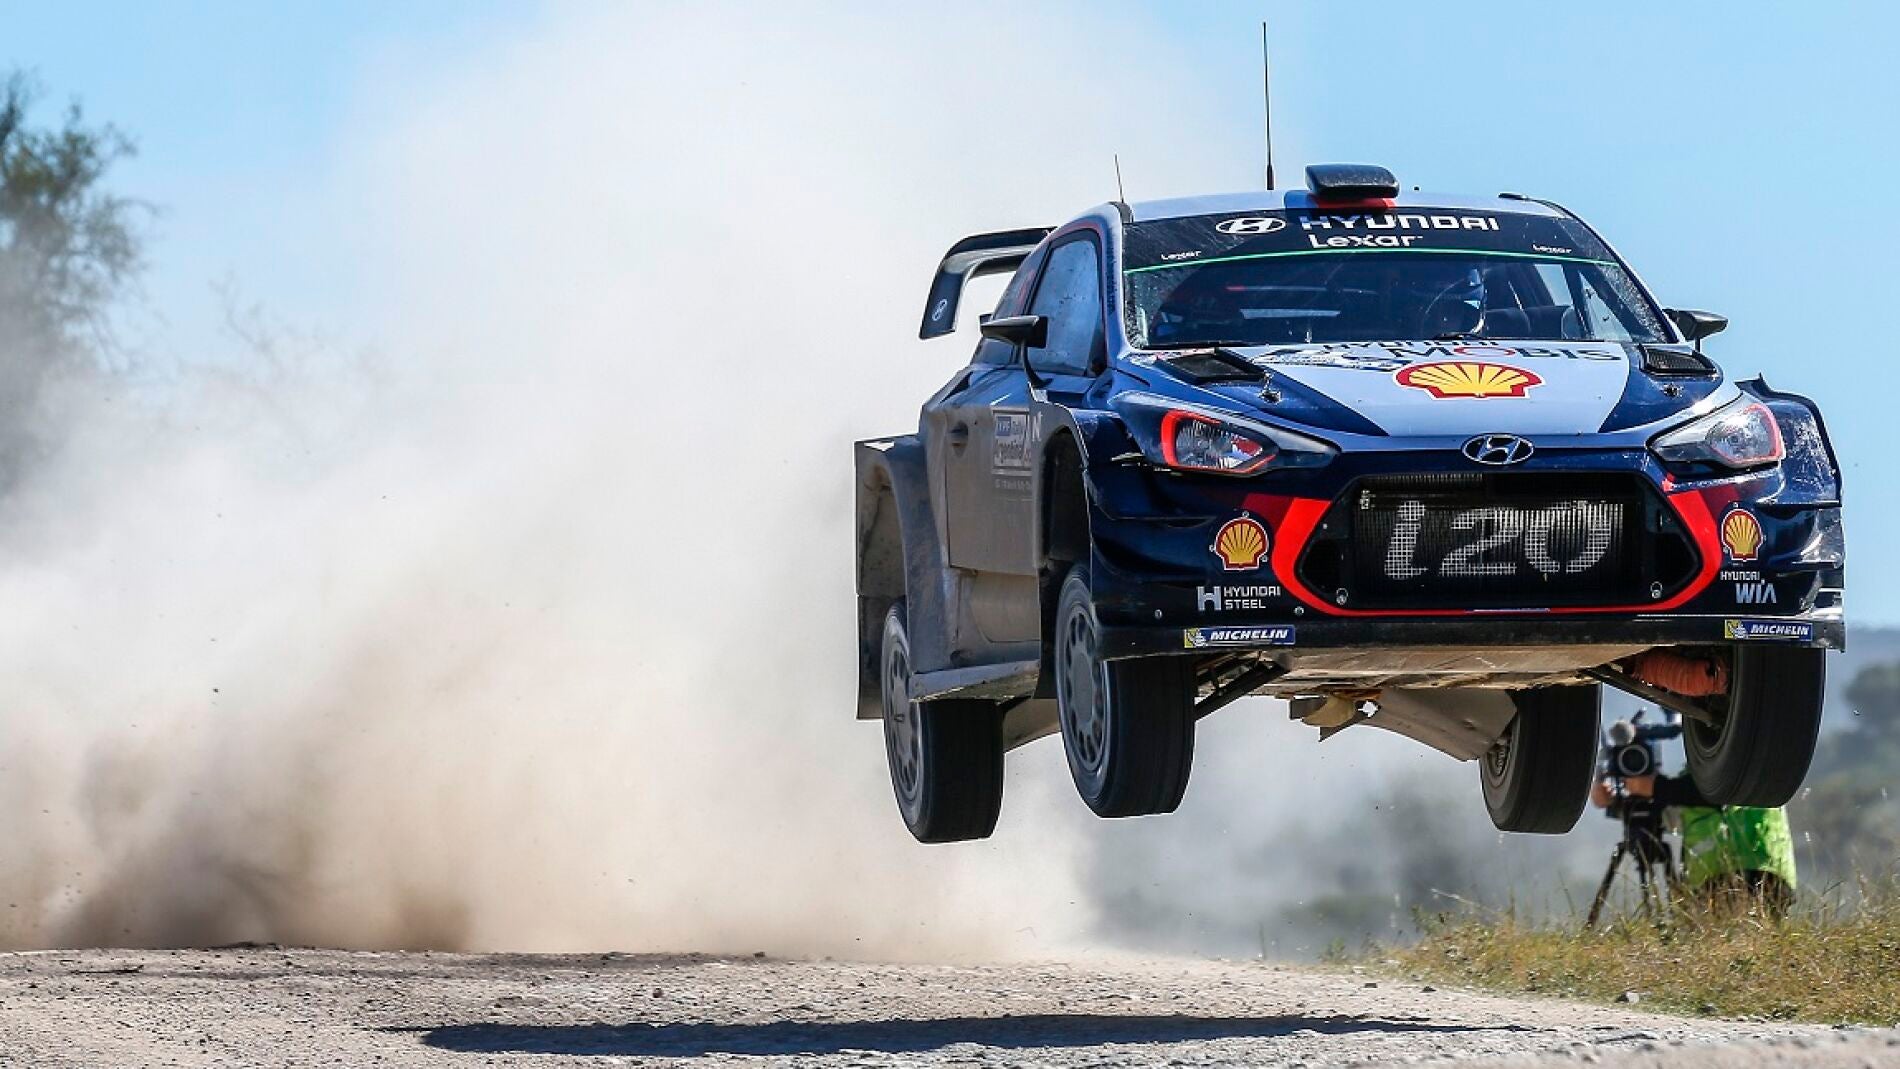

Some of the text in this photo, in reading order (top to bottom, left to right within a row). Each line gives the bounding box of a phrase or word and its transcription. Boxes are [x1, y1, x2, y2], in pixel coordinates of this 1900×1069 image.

[1299, 214, 1500, 231] HYUNDAI
[1307, 234, 1419, 249] Lexar
[1385, 346, 1622, 361] MOBIS
[1720, 570, 1761, 581] HYUNDAI
[1223, 585, 1281, 597] HYUNDAI
[1225, 599, 1267, 610] STEEL
[1210, 629, 1290, 641] MICHELIN
[1750, 624, 1810, 636] MICHELIN
